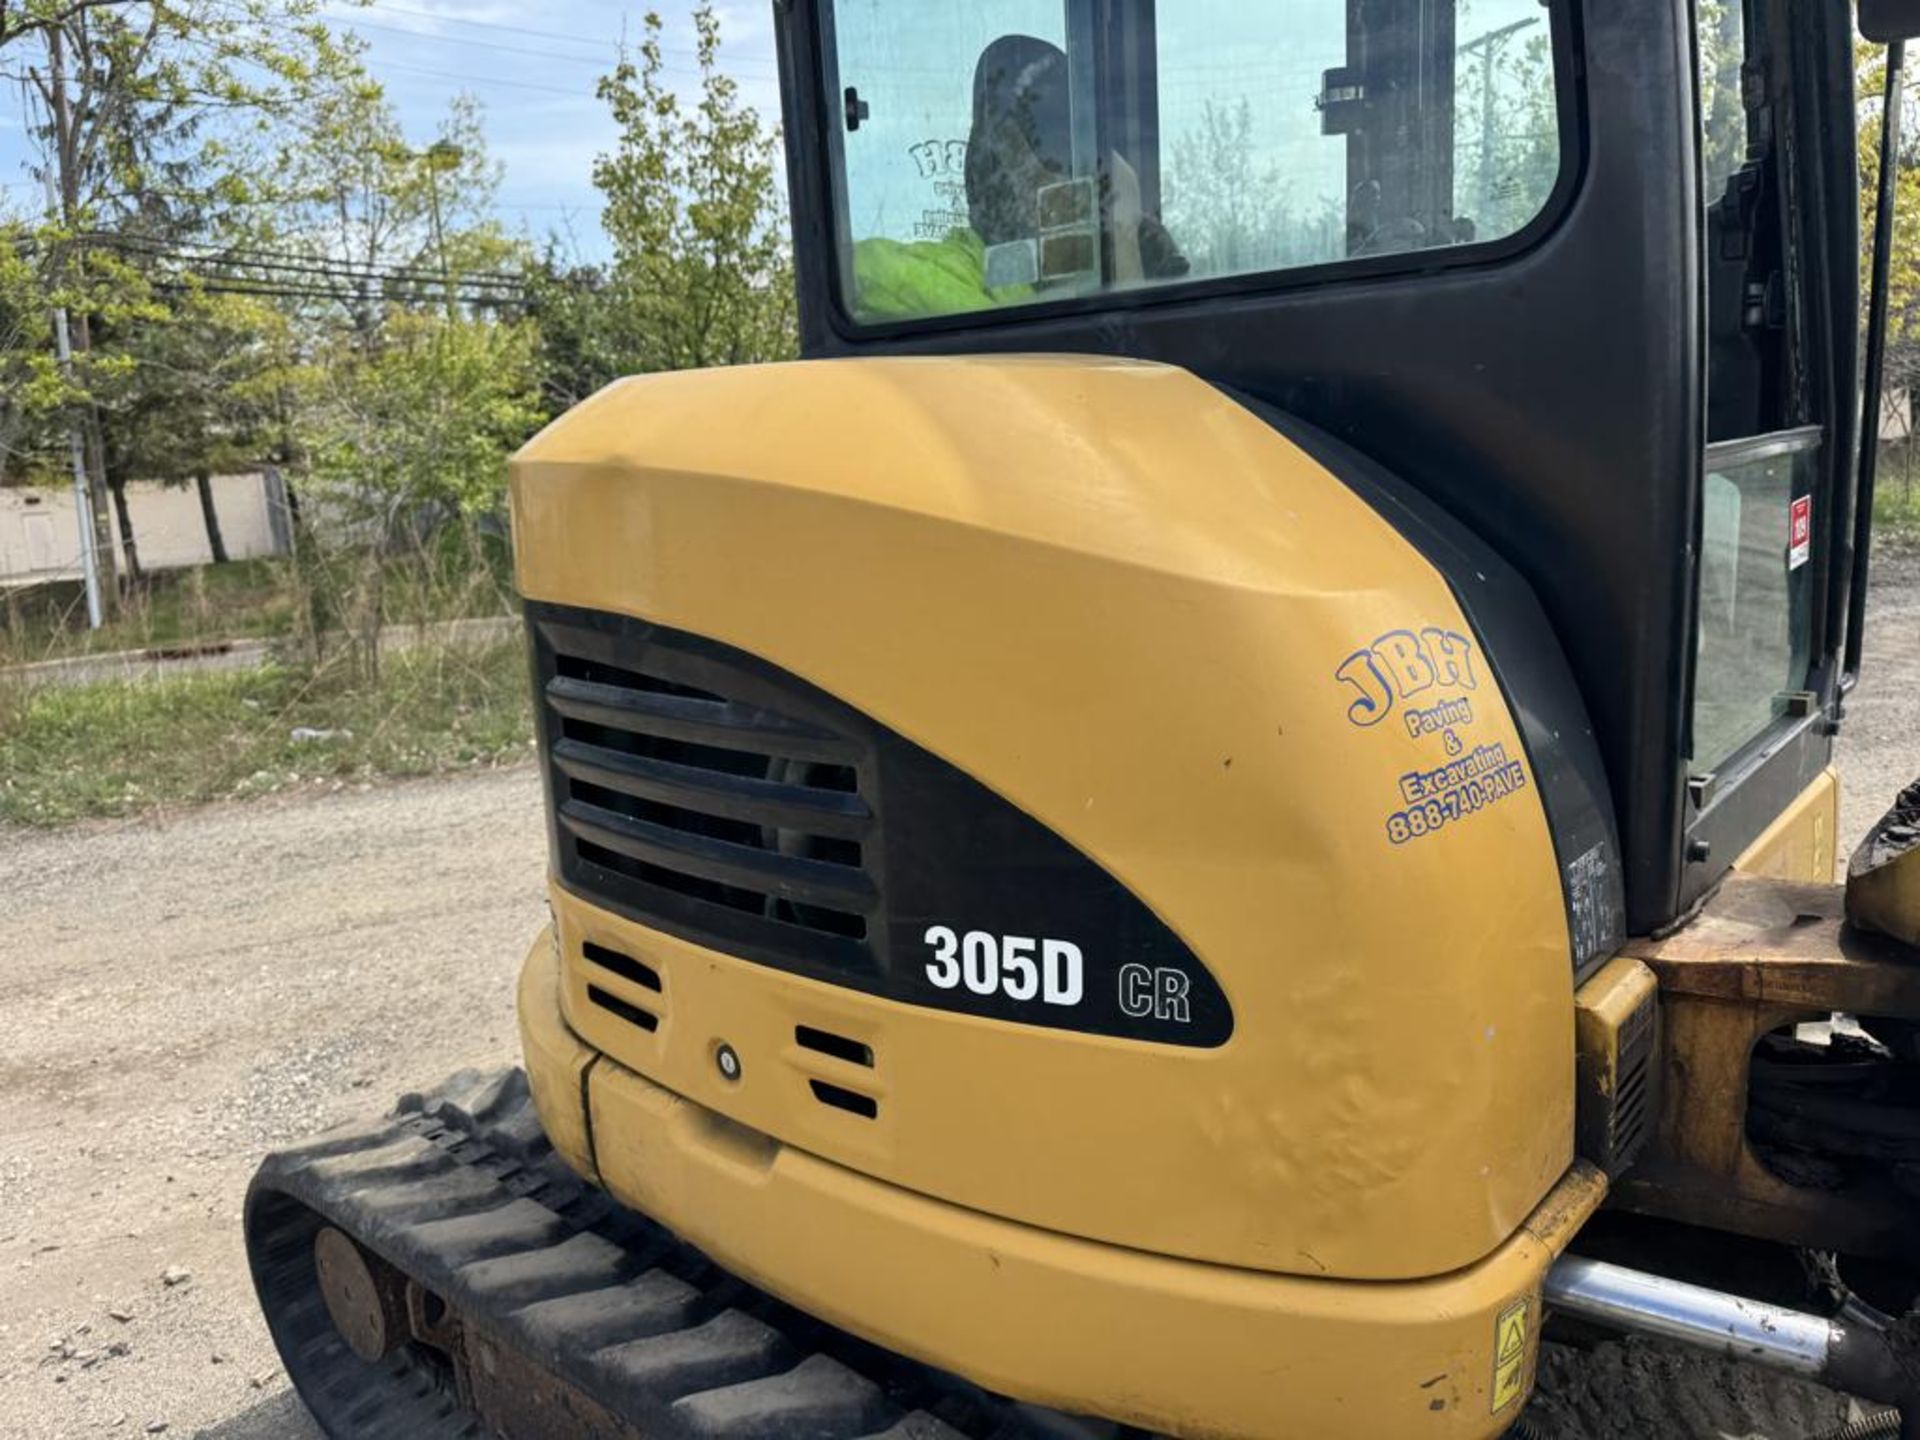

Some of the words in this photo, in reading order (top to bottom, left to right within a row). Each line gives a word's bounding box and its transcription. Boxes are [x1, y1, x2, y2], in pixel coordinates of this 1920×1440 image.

[1335, 627, 1477, 727] JBH
[1404, 697, 1472, 738] Paving
[1443, 728, 1462, 756] &
[1386, 761, 1525, 844] 888-740-PAVE
[1399, 743, 1506, 804] Excavating
[924, 925, 1083, 1006] 305D
[1118, 963, 1190, 1022] CR
